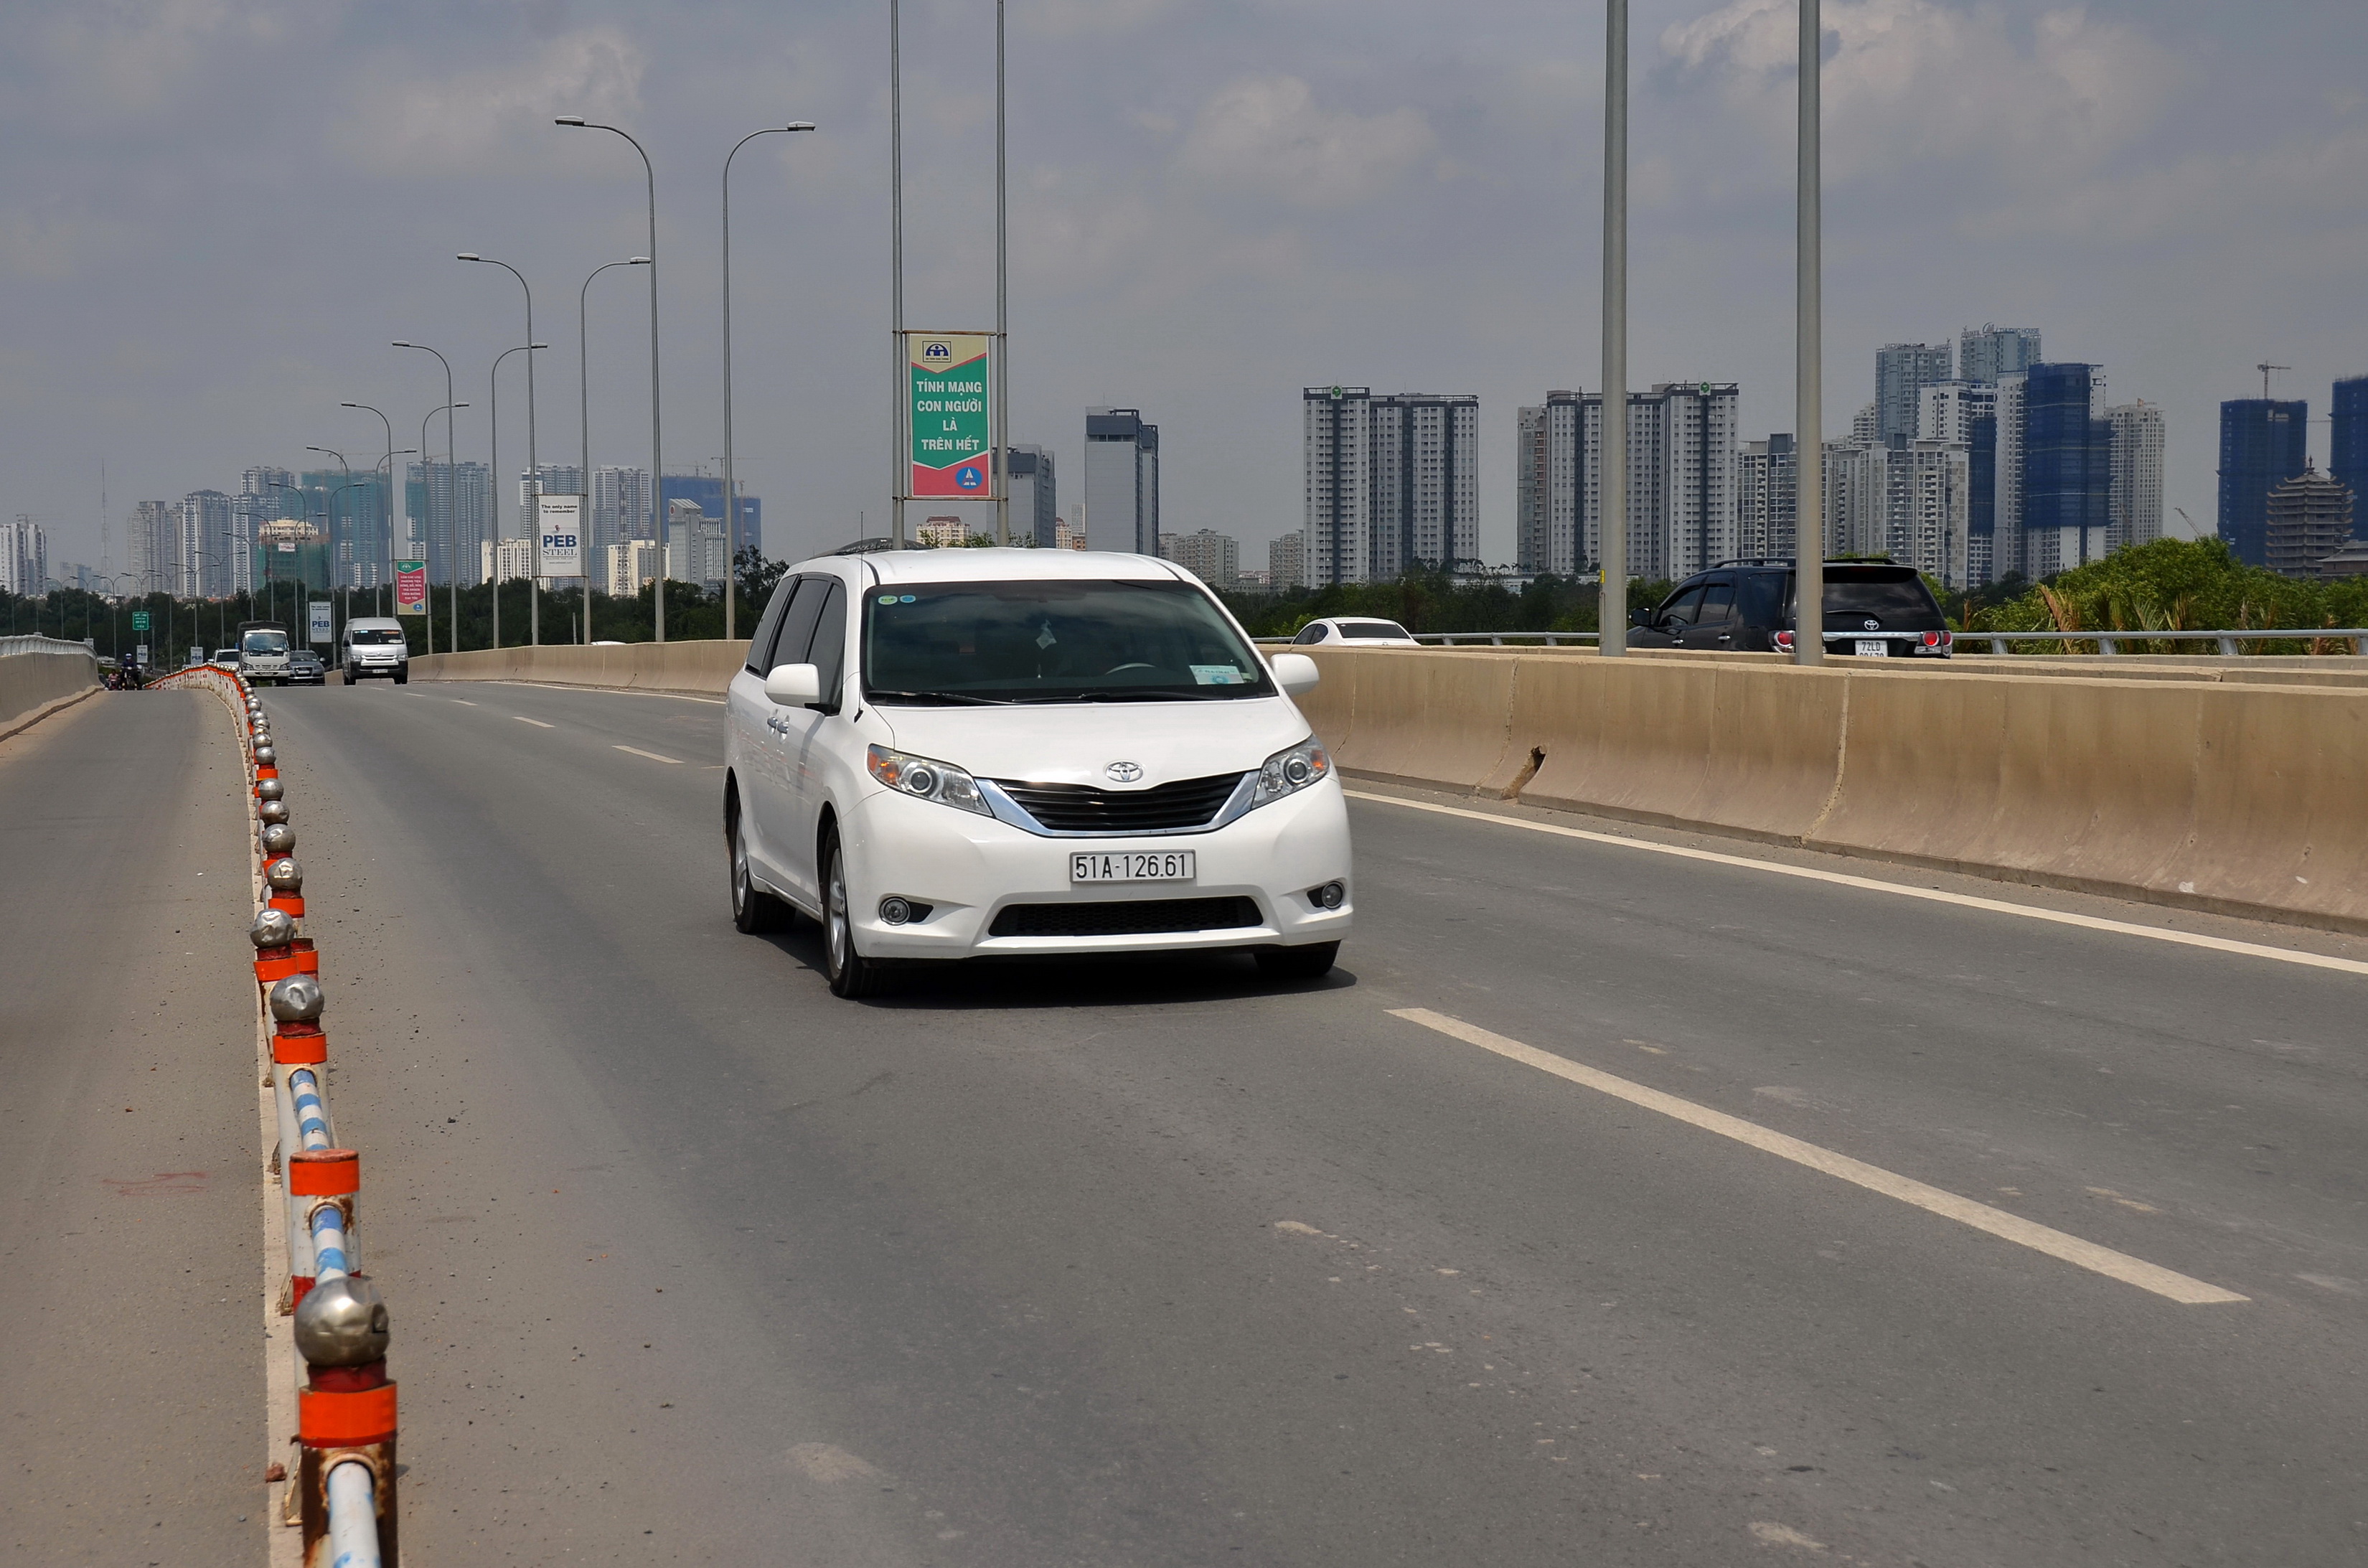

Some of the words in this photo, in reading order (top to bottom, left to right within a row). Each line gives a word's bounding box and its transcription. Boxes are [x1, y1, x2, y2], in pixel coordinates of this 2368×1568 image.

[916, 378, 944, 393] TÍNH
[948, 381, 982, 396] MẠNG
[917, 400, 941, 412] CON
[945, 398, 982, 413] NGƯỜI
[942, 417, 958, 431] LÀ
[921, 436, 952, 451] TRÊN
[956, 435, 979, 451] HẾT
[542, 535, 577, 548] PEB
[1861, 642, 1881, 652] 72LD
[1076, 853, 1185, 878] 51A-126.61
